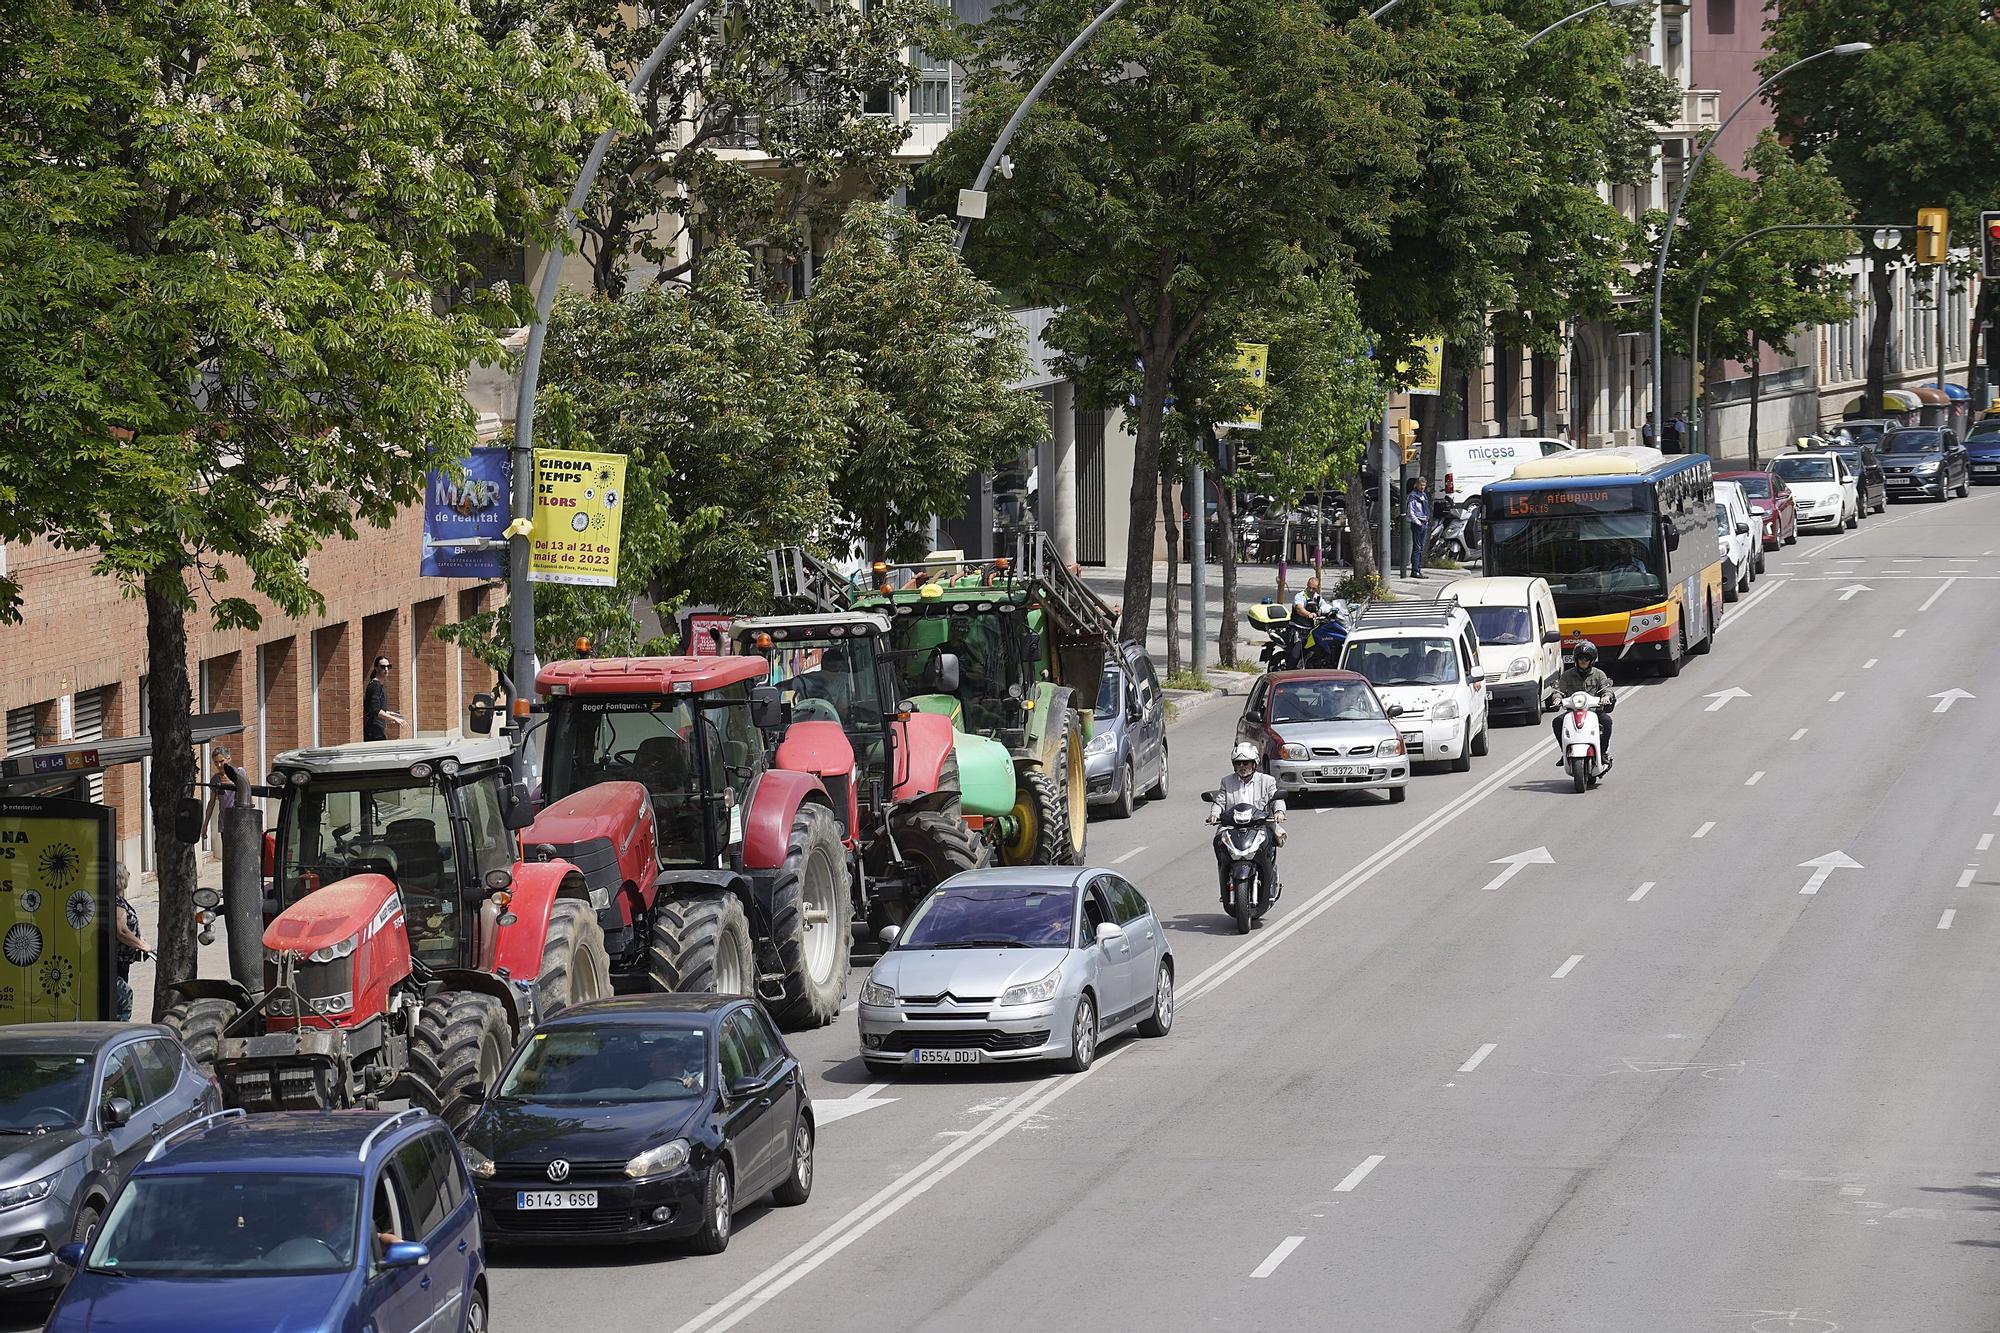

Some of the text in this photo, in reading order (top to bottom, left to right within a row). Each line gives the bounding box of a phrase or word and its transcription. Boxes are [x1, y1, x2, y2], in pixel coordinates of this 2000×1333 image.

[1468, 445, 1515, 459] micesa
[539, 459, 593, 471] GIRONA
[539, 471, 582, 483] TEMPS
[435, 480, 500, 506] MAR
[539, 484, 554, 494] DE
[538, 496, 577, 507] FLORS
[1547, 491, 1609, 504] AIGUAVIVA
[1509, 495, 1530, 516] L5
[435, 511, 449, 522] de
[535, 540, 611, 554] Del 13 al 21 de
[534, 552, 610, 565] maig de 2023
[582, 703, 604, 712] Roger
[35, 755, 96, 769] L-6 L-5 L-2 L-1
[921, 1050, 977, 1063] 6554 DDJ
[525, 1193, 595, 1207] 6143 GSC
